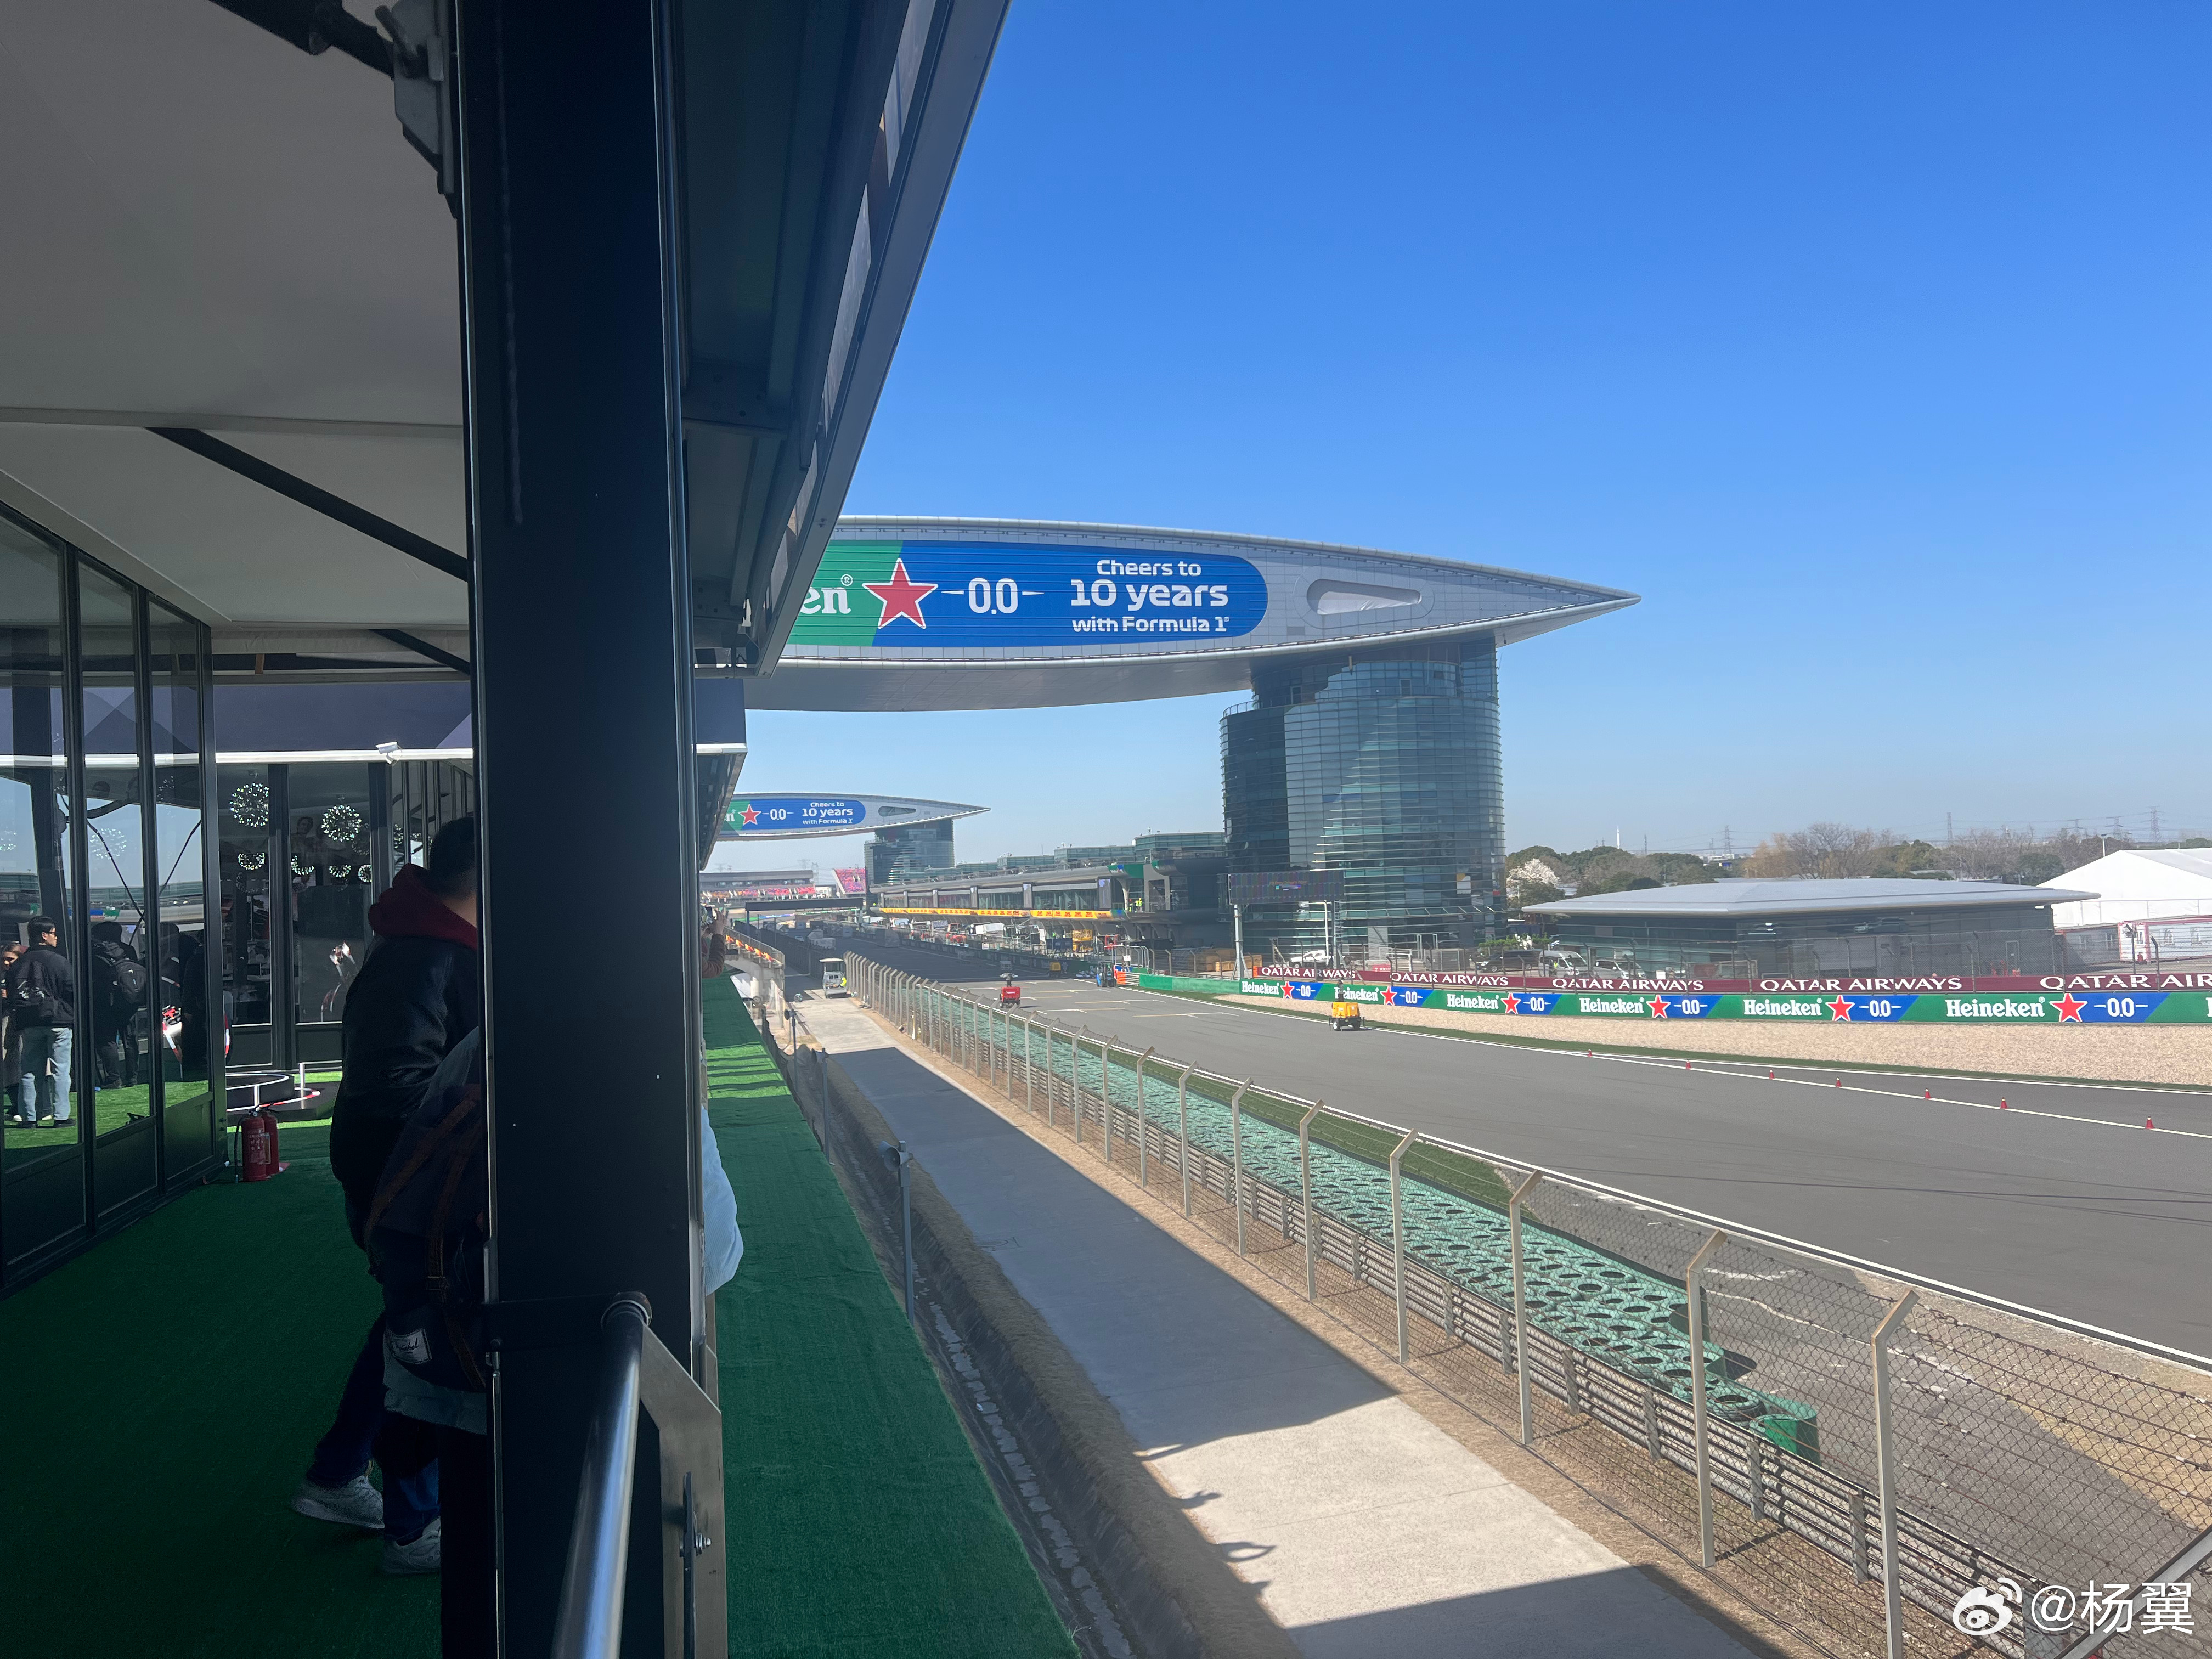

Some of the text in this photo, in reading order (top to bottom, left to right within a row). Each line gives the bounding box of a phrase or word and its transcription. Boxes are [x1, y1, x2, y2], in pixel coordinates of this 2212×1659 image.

[1097, 560, 1201, 575] Cheers to
[969, 578, 1018, 614] 0.0
[1071, 579, 1228, 611] 10 years
[1073, 617, 1118, 632] with
[1122, 617, 1209, 631] Formula
[803, 808, 853, 817] 10 years
[1261, 967, 1355, 979] QATAR AIRWAYS
[1390, 972, 1509, 986] QATAR AIRWAYS
[1552, 978, 1704, 991] QATAR AIRWAYS
[1760, 978, 1962, 991] QATAR AIRWAYS
[2040, 975, 2151, 990] QATAR
